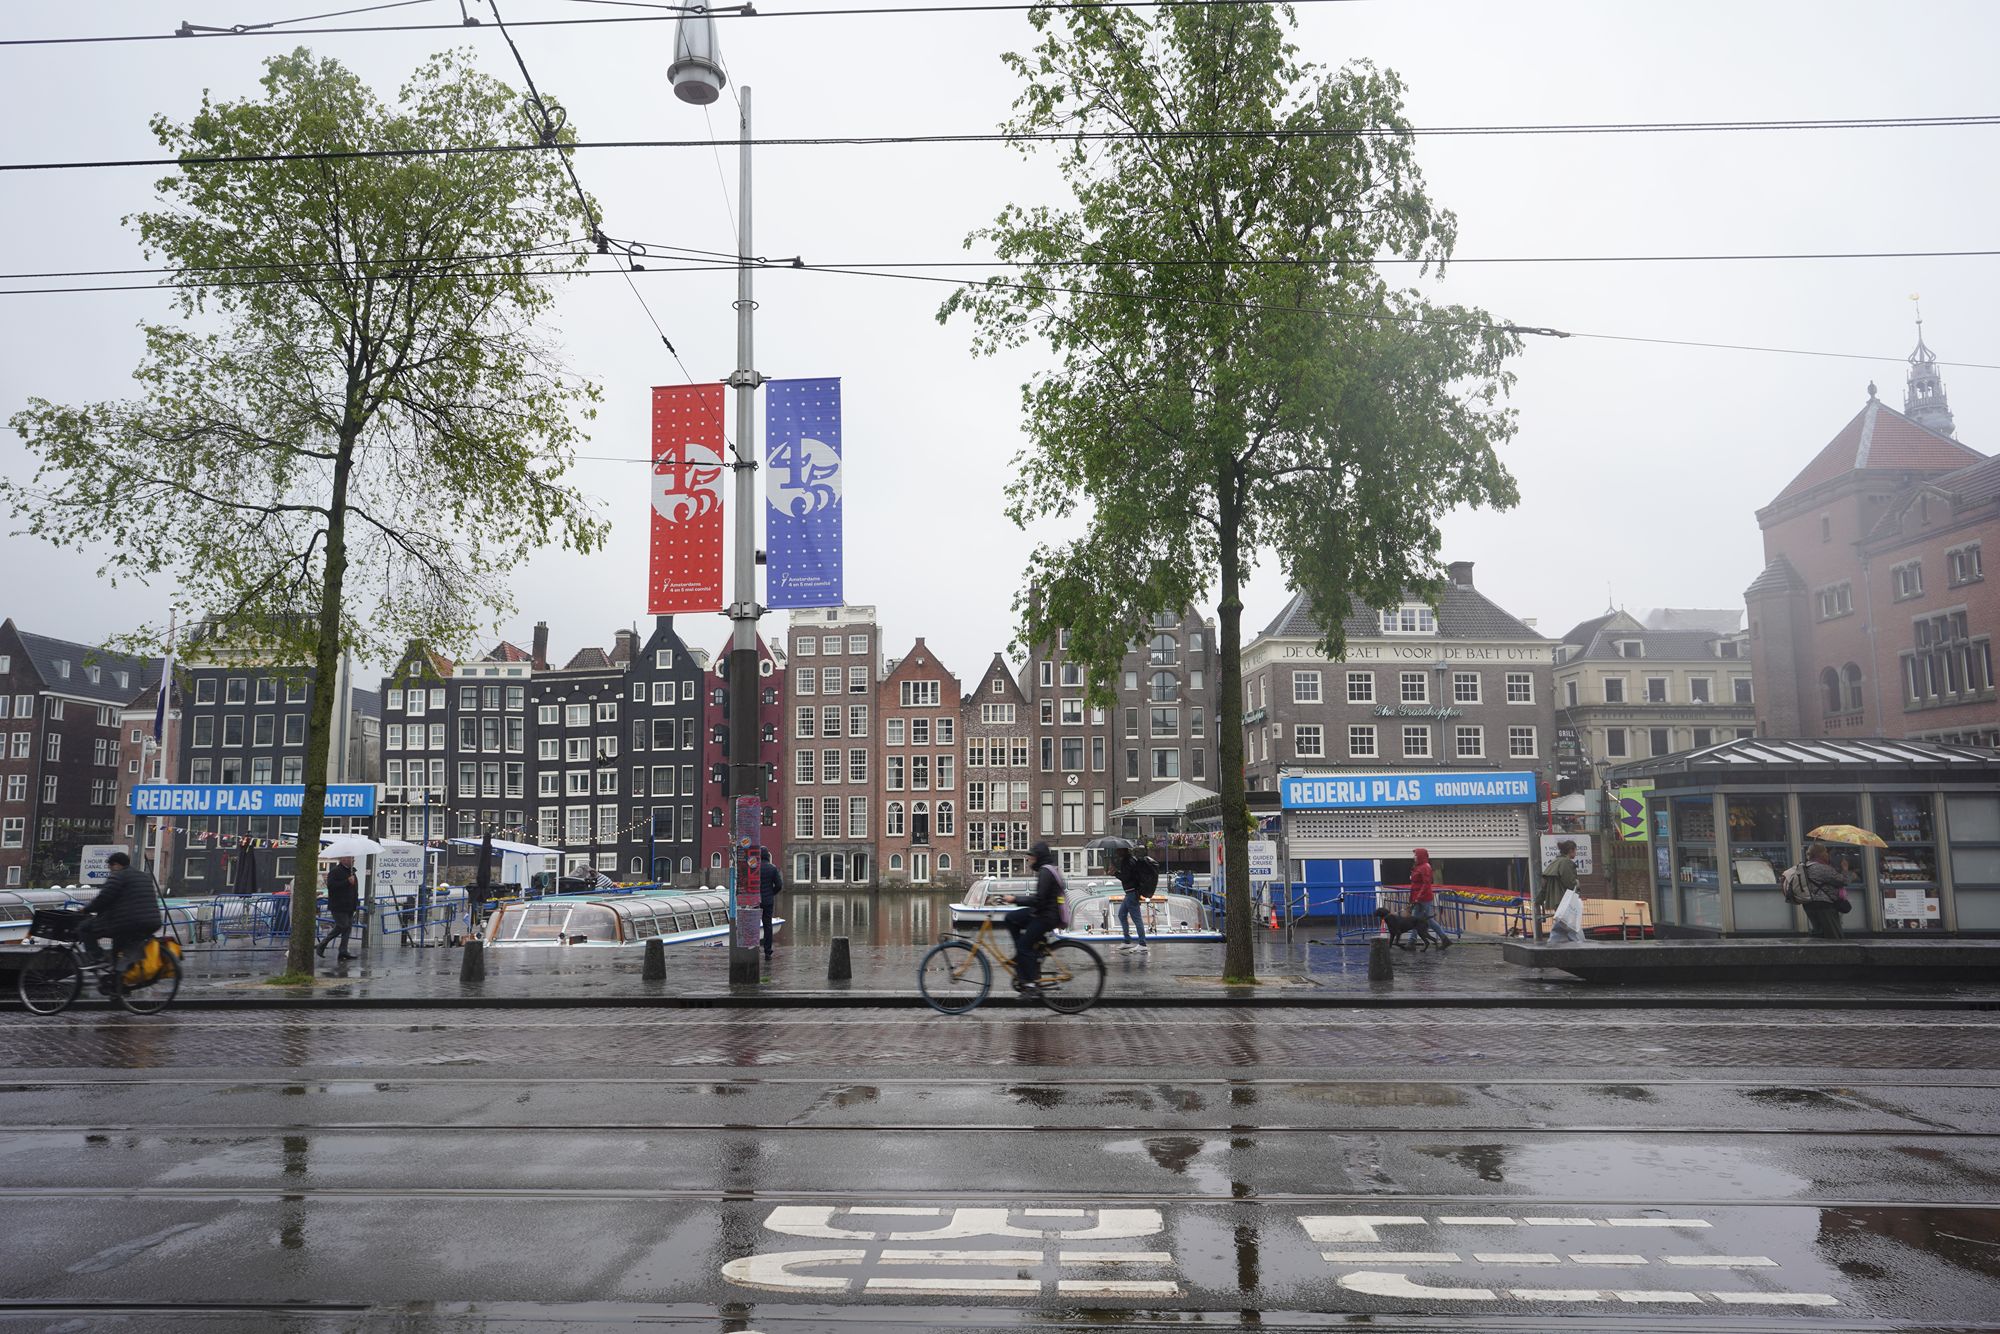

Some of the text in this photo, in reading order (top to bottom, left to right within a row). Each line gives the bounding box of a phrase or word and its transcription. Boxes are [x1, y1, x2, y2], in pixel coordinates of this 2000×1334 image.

[1345, 646, 1383, 658] GAET
[1393, 646, 1432, 659] VOOR
[1444, 647, 1462, 659] DE
[1466, 647, 1502, 659] BAET
[1374, 703, 1464, 720] The Grasshopper
[136, 789, 364, 811] REDERIJ PLAS RONDARTEN
[1290, 780, 1529, 804] REDERIJ PLAS RONDVAARTEN
